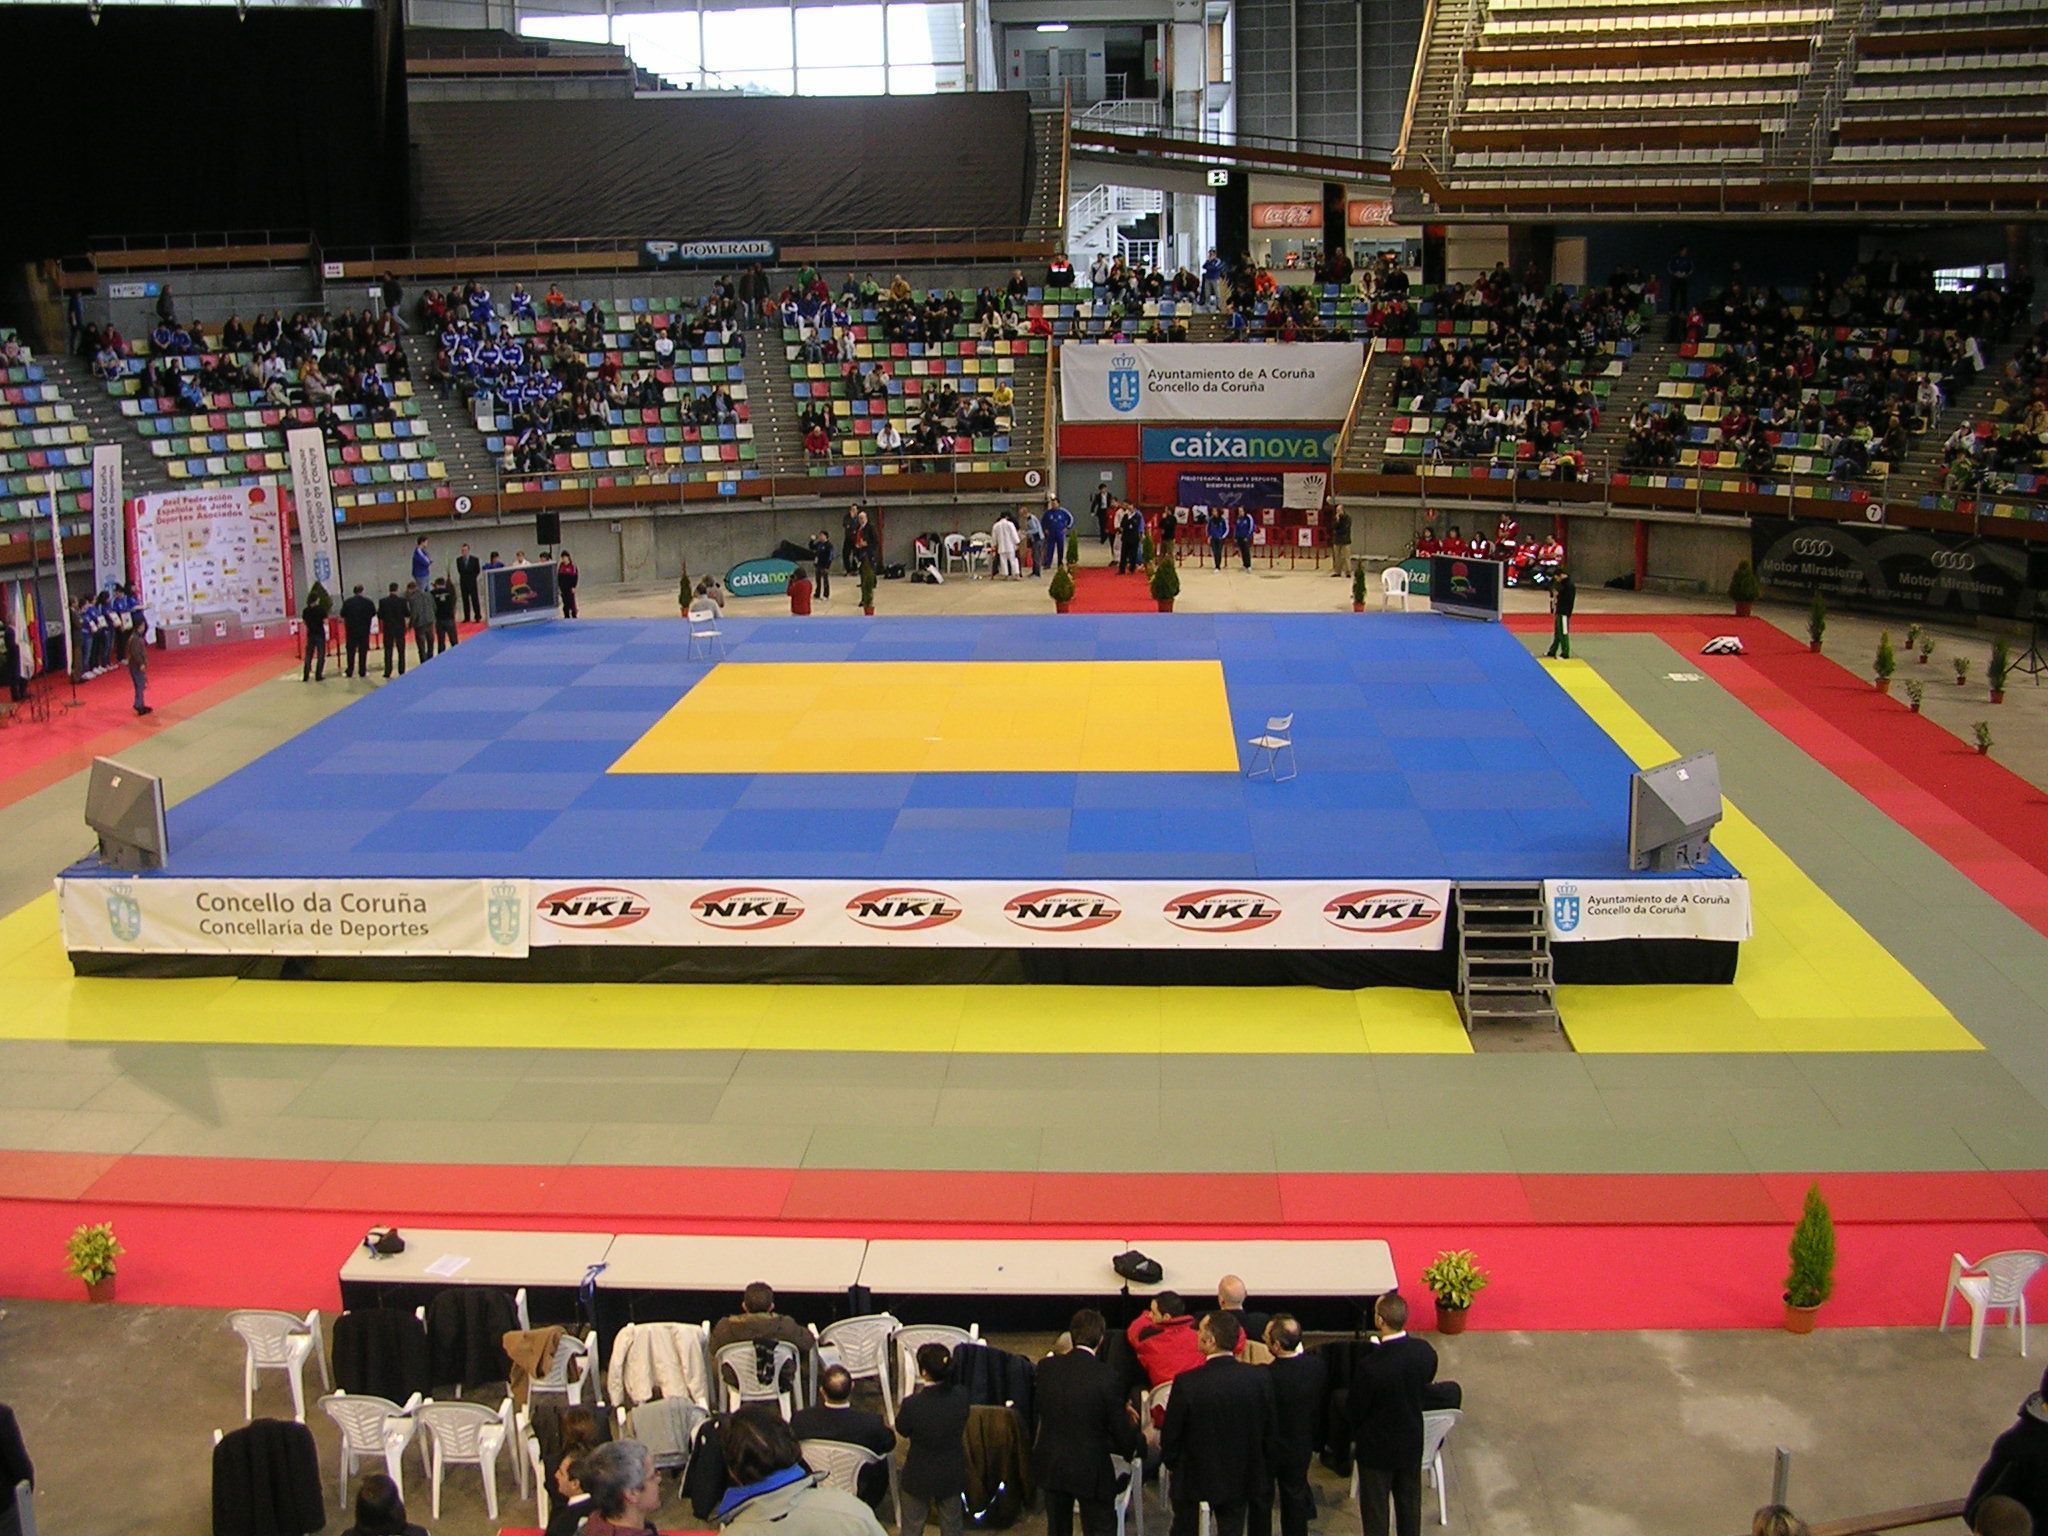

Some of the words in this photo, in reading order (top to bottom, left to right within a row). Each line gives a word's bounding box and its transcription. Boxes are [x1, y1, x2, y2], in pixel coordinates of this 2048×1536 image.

[682, 242, 770, 257] POWERADE
[1147, 368, 1235, 382] Ayuntamiento
[1238, 368, 1254, 379] de
[1258, 368, 1267, 379] A
[1271, 368, 1315, 379] Coruña
[1148, 381, 1200, 392] Concello
[1202, 381, 1218, 392] da
[1221, 381, 1265, 392] Coruña
[1170, 431, 1320, 458] caixanova
[163, 497, 180, 506] Real
[183, 494, 233, 503] Federación
[100, 506, 108, 520] da
[157, 505, 193, 516] Española
[210, 502, 232, 510] Judo
[156, 515, 193, 525] Deportes
[197, 511, 243, 519] Asociados
[101, 523, 109, 567] Concello
[1764, 560, 1799, 574] Motor
[1802, 562, 1864, 580] Mirasierra
[733, 572, 787, 587] caixano
[1899, 573, 1936, 588] Motor
[1941, 577, 2004, 596] Mirasierra
[197, 892, 295, 913] Concello
[303, 892, 332, 913] da
[340, 892, 427, 913] Coruña
[1587, 894, 1662, 906] Ayuntamiento
[1664, 894, 1678, 903] de
[1681, 894, 1689, 903] A
[1692, 894, 1730, 904] Coruña
[549, 901, 643, 917] NKL
[702, 901, 798, 917] NKL
[858, 902, 955, 918] NKL
[1016, 903, 1115, 919] NKL
[1177, 903, 1275, 920] NKL
[1336, 903, 1435, 920] NKL
[1587, 905, 1631, 915] Concello
[1633, 905, 1646, 914] da
[1649, 905, 1686, 914] Coruña
[199, 918, 304, 935] Concellaría
[310, 918, 333, 936] de
[340, 919, 429, 940] Deportes
